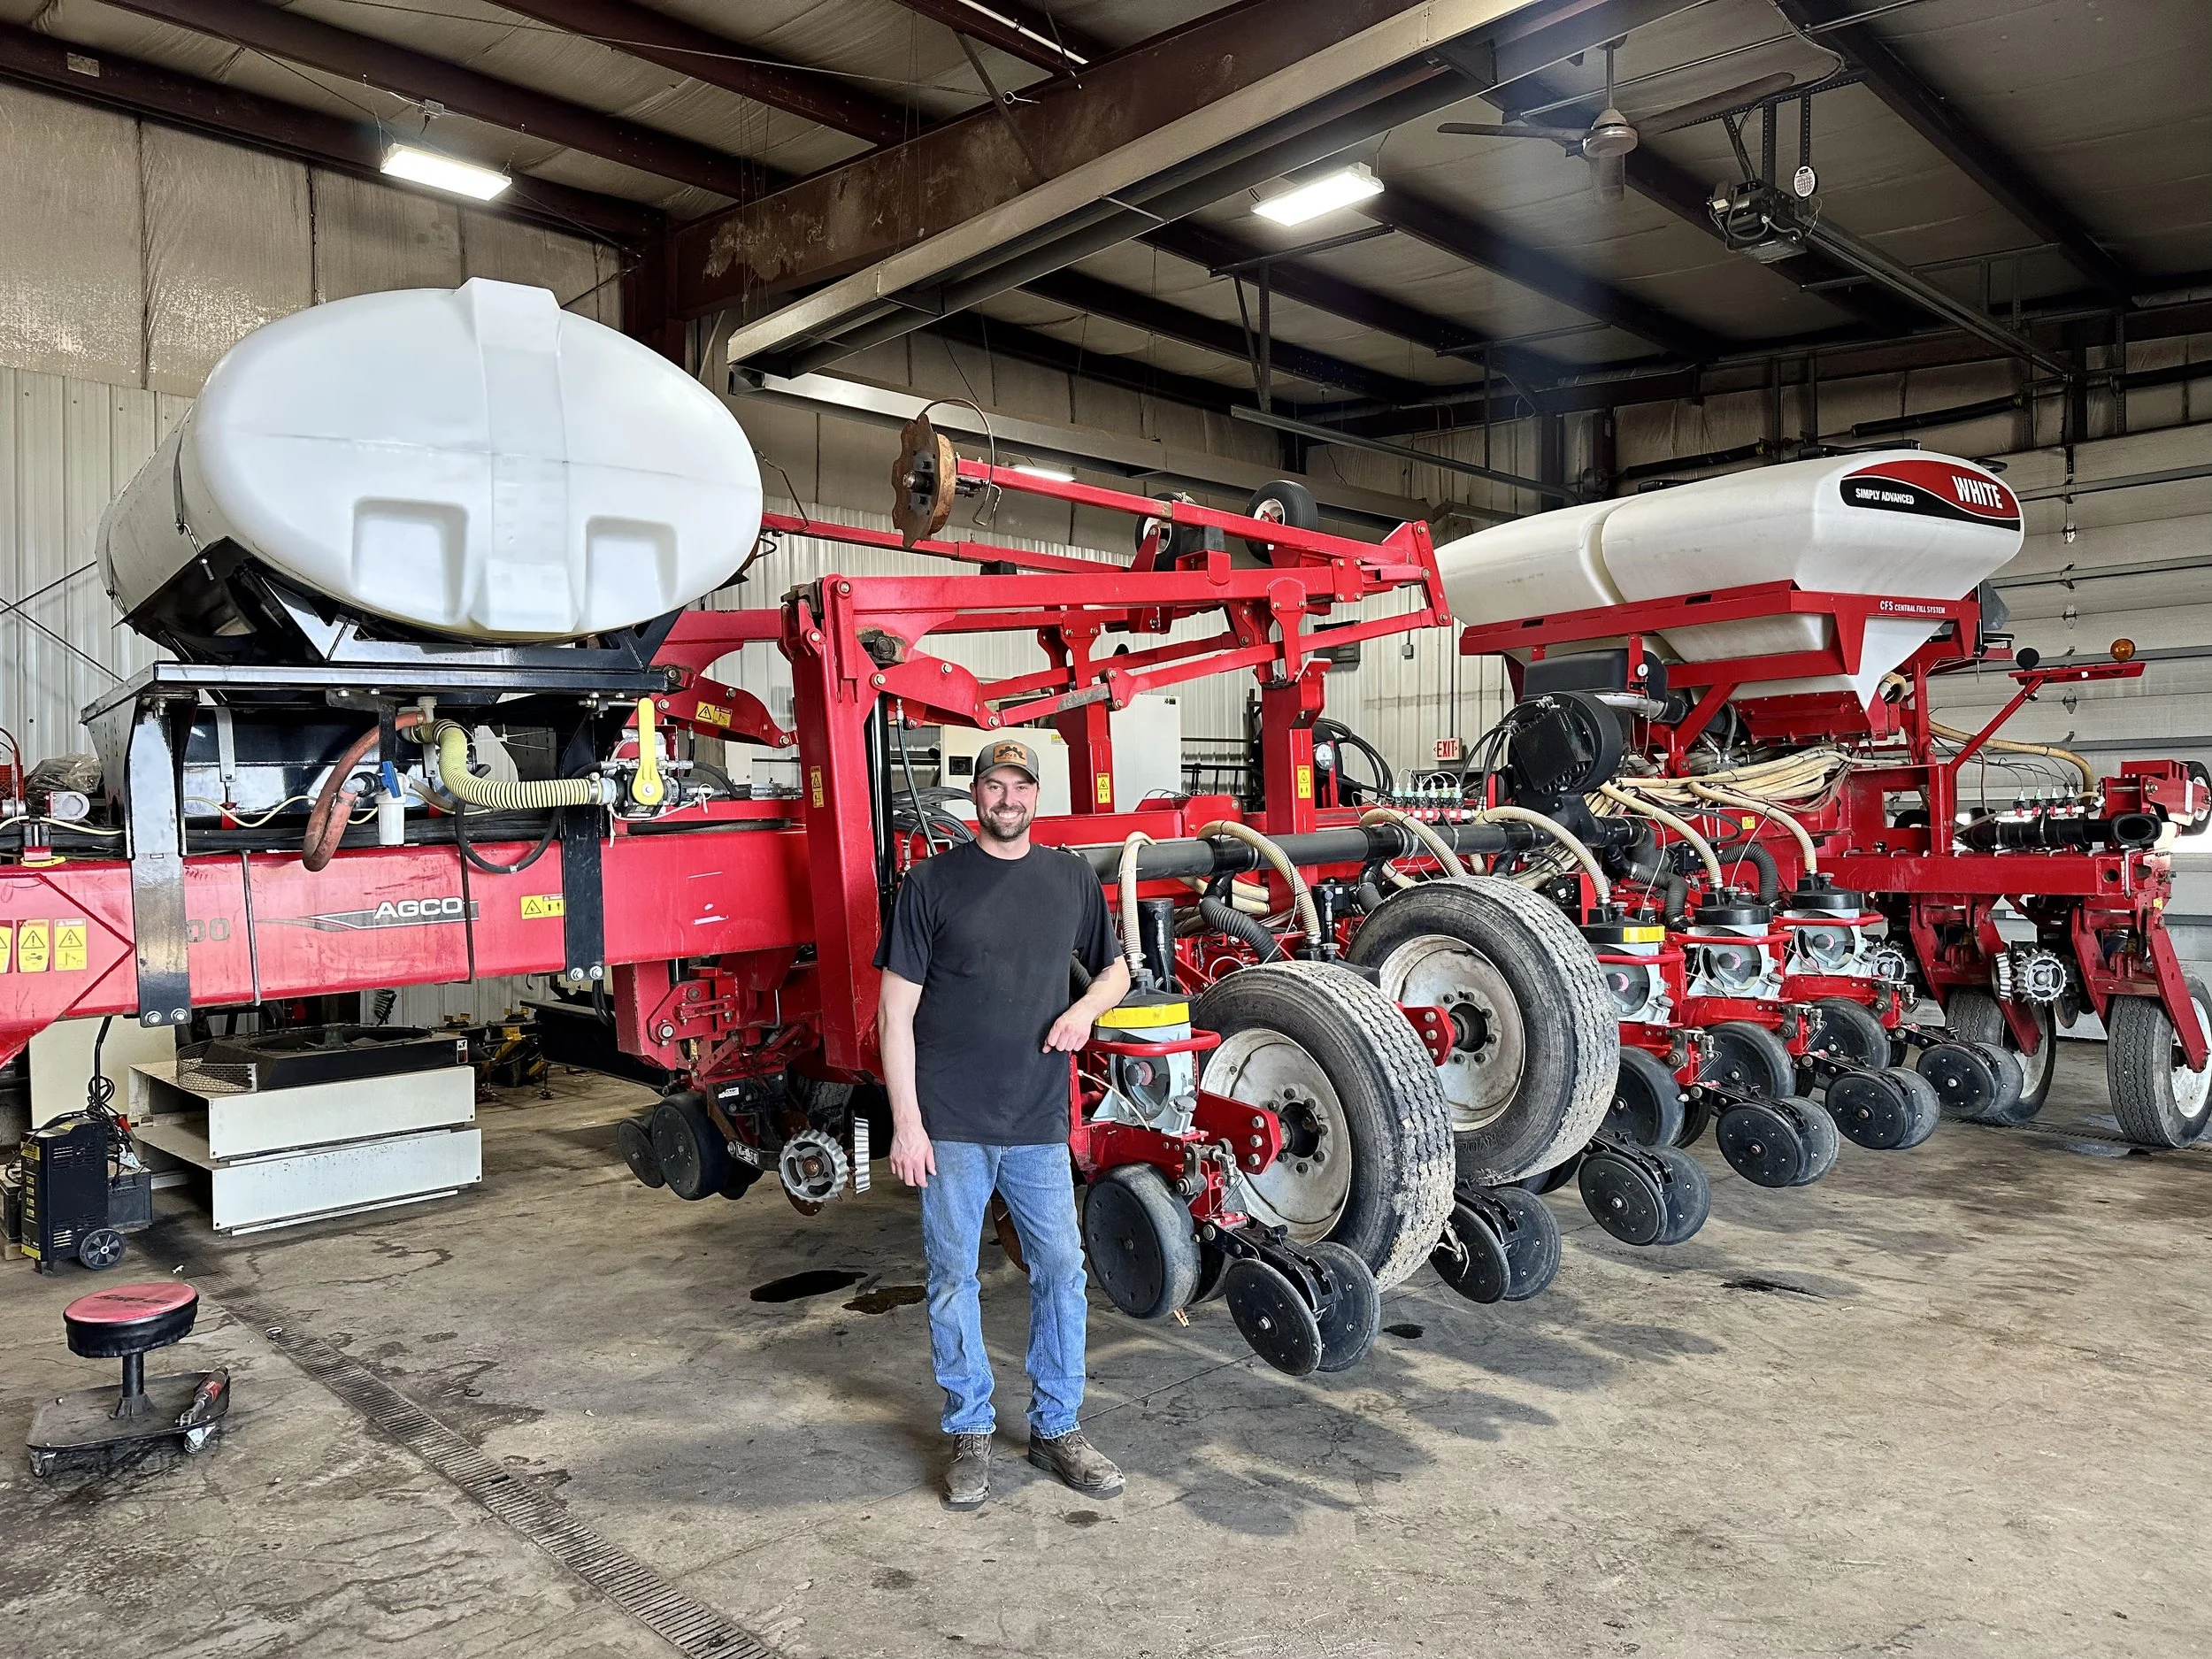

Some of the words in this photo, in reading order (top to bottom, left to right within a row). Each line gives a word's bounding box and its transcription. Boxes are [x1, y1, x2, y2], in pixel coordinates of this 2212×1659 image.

[1855, 488, 1880, 501] SIMPLY
[1881, 491, 1915, 505] ADVANCED
[1952, 475, 2003, 509] WHITE
[1879, 600, 1893, 611] CFS
[1894, 603, 1916, 612] CENTRAL
[1927, 605, 1946, 614] SYSTEM
[1437, 741, 1455, 757] EXIT
[374, 896, 463, 919] AGCO
